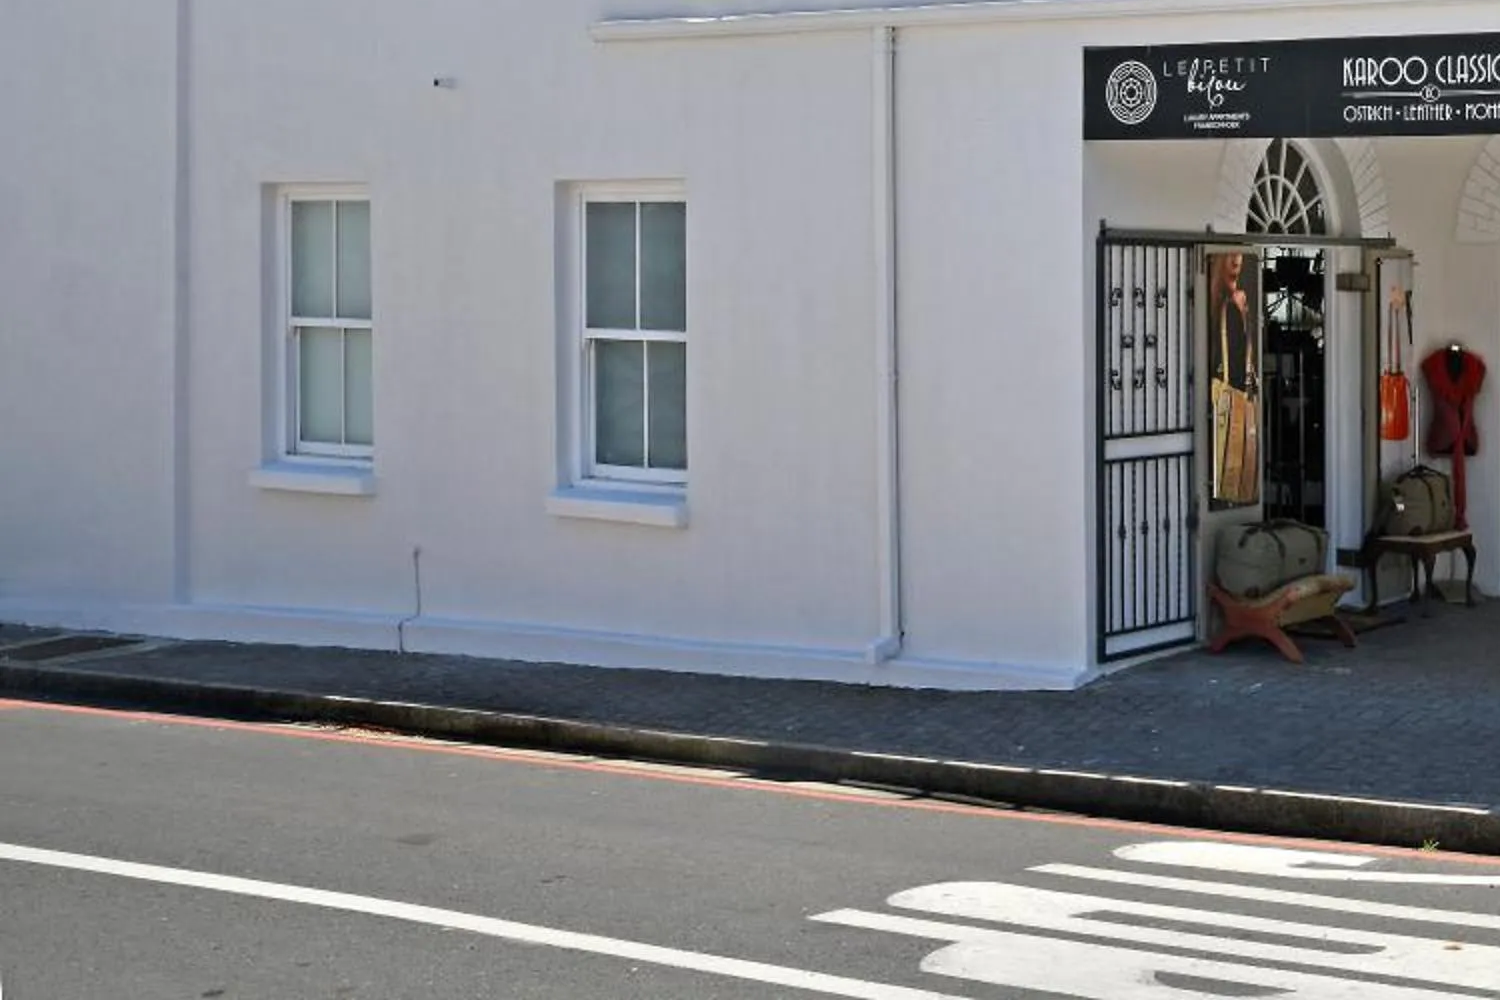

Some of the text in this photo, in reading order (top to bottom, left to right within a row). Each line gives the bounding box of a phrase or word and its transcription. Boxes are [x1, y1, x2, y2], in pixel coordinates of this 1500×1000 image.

[1163, 57, 1271, 77] LE PETIT
[1343, 57, 1428, 87] KAROO
[1343, 105, 1393, 123] OSTRICH
[1402, 103, 1453, 122] LEATHER
